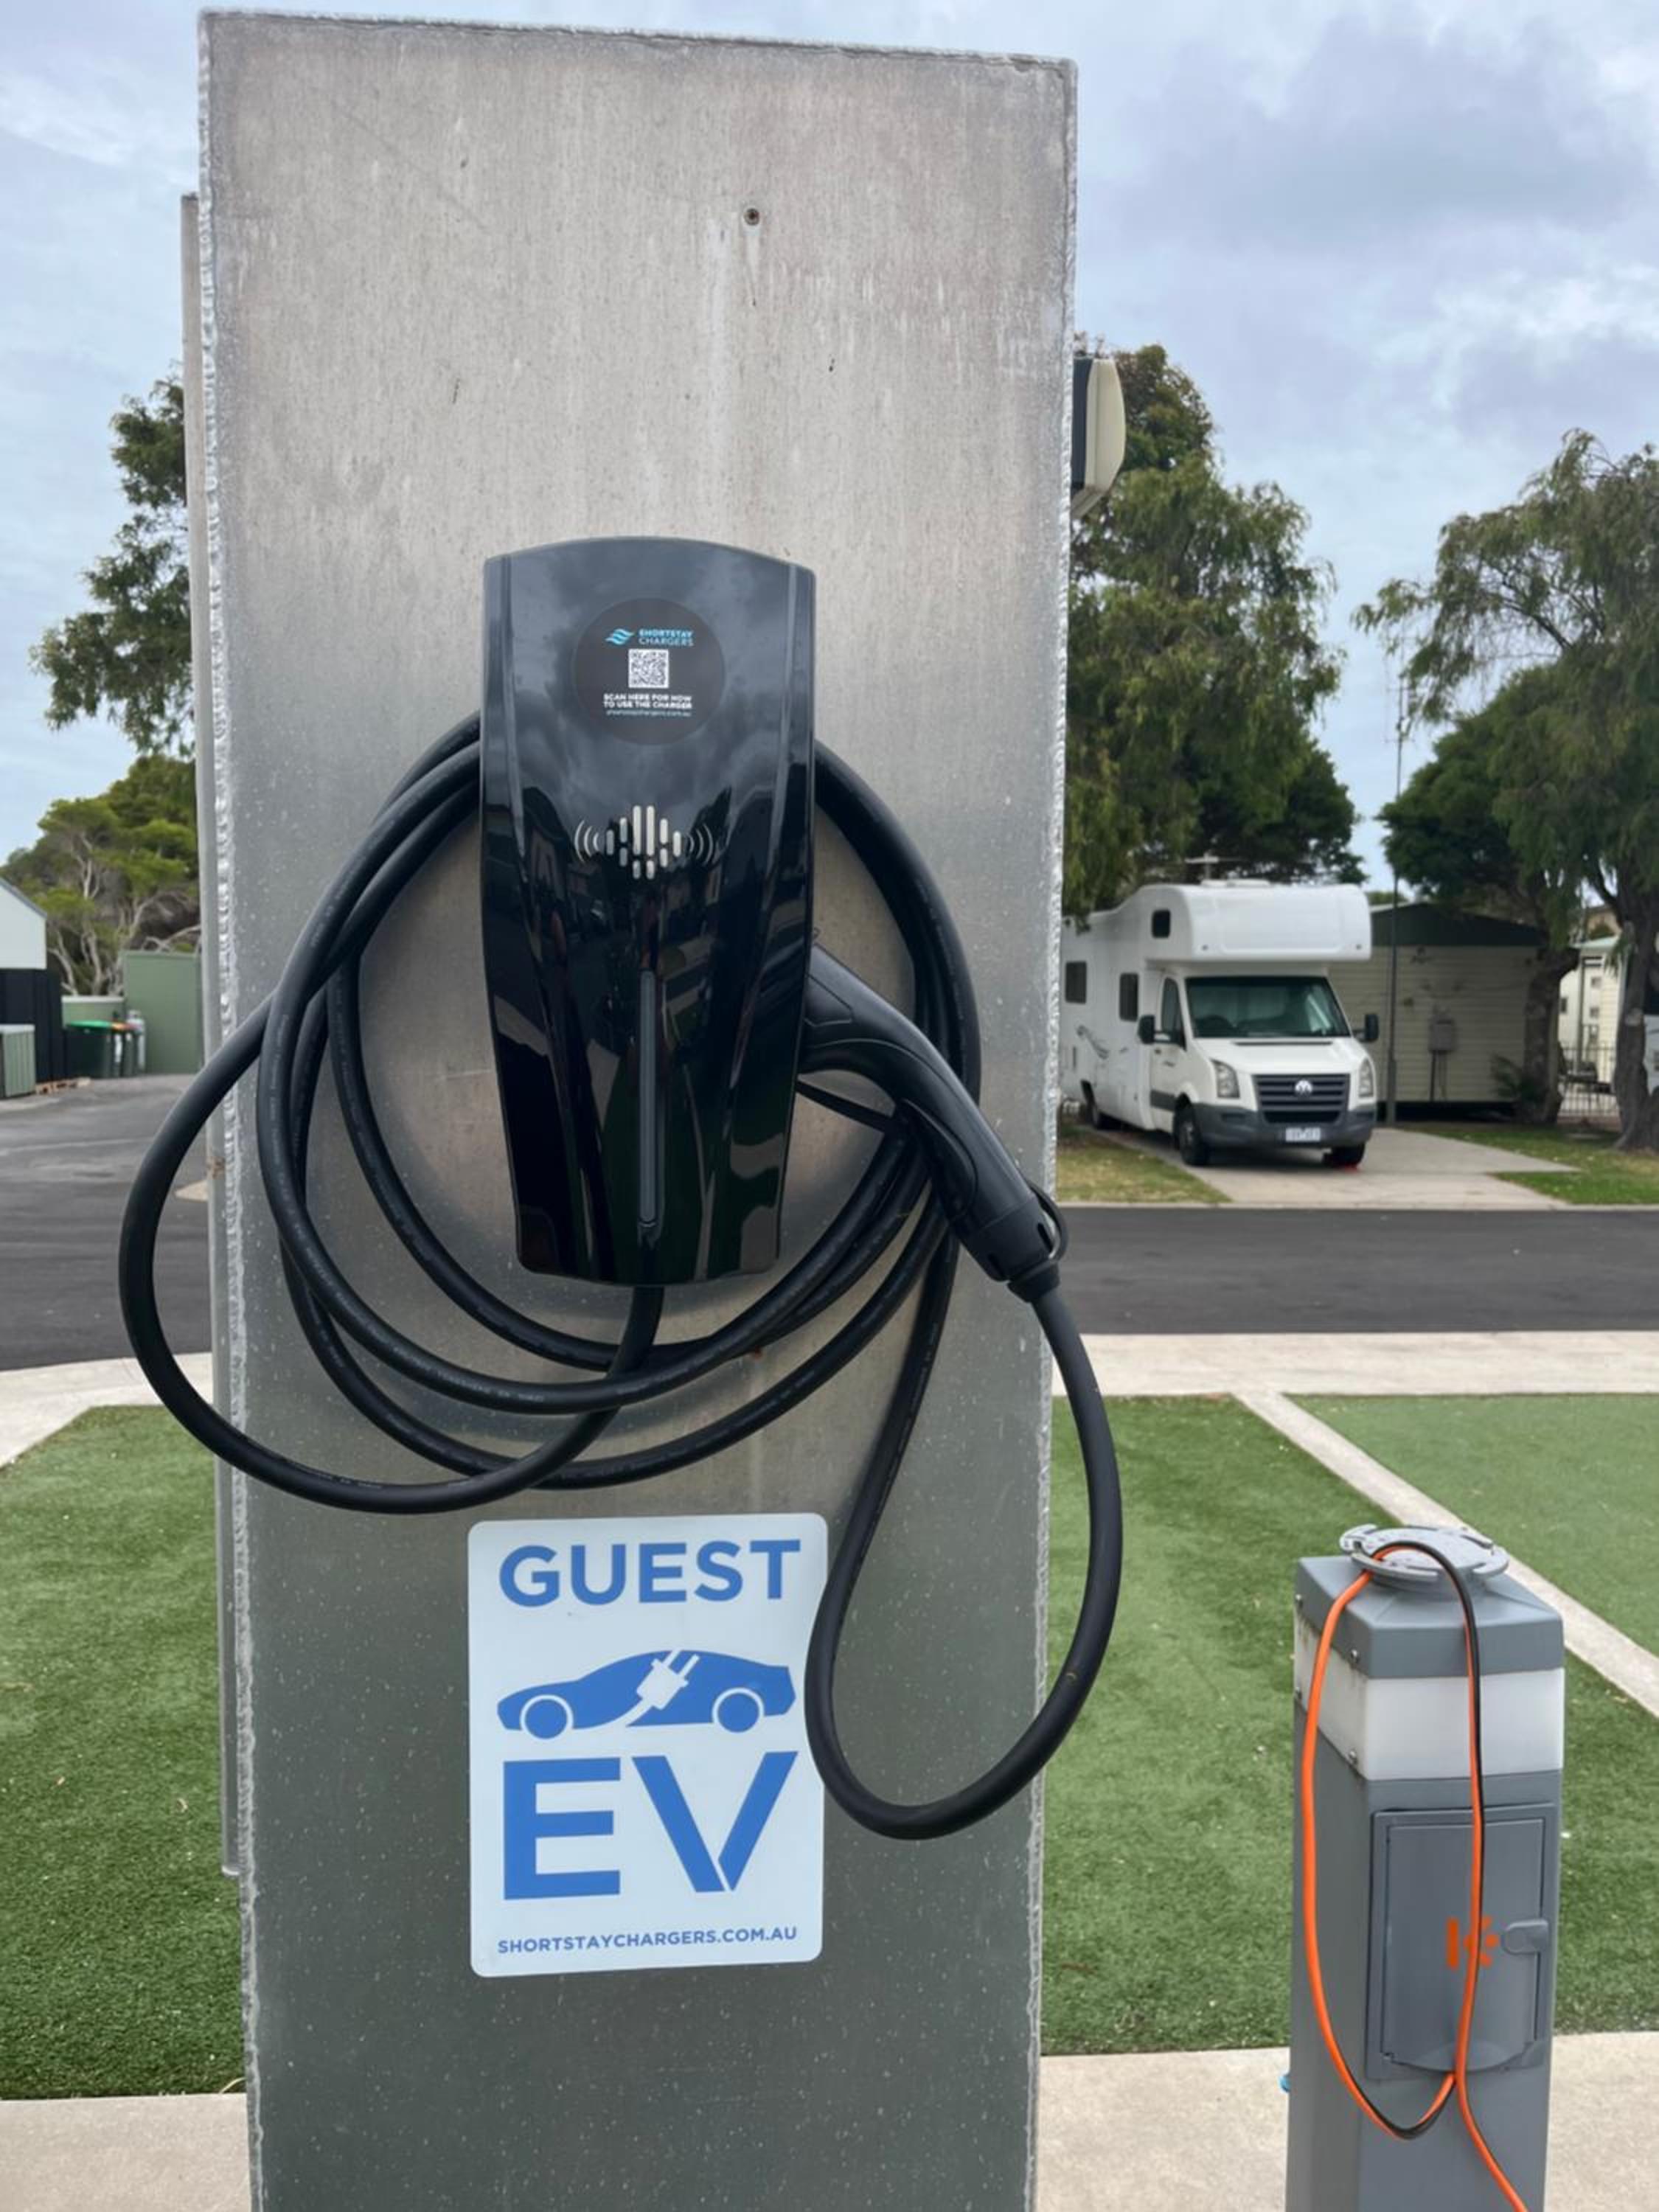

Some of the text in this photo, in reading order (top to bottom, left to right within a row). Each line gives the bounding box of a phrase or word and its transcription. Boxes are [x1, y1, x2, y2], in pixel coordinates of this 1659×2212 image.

[639, 629, 693, 638] SHORTSTAY
[639, 637, 694, 646] CHARGERS
[499, 1539, 801, 1607] GUEST
[503, 1751, 799, 1901] EV
[498, 1926, 797, 1954] SHORTSTAYCHARGERS.COM.AU
